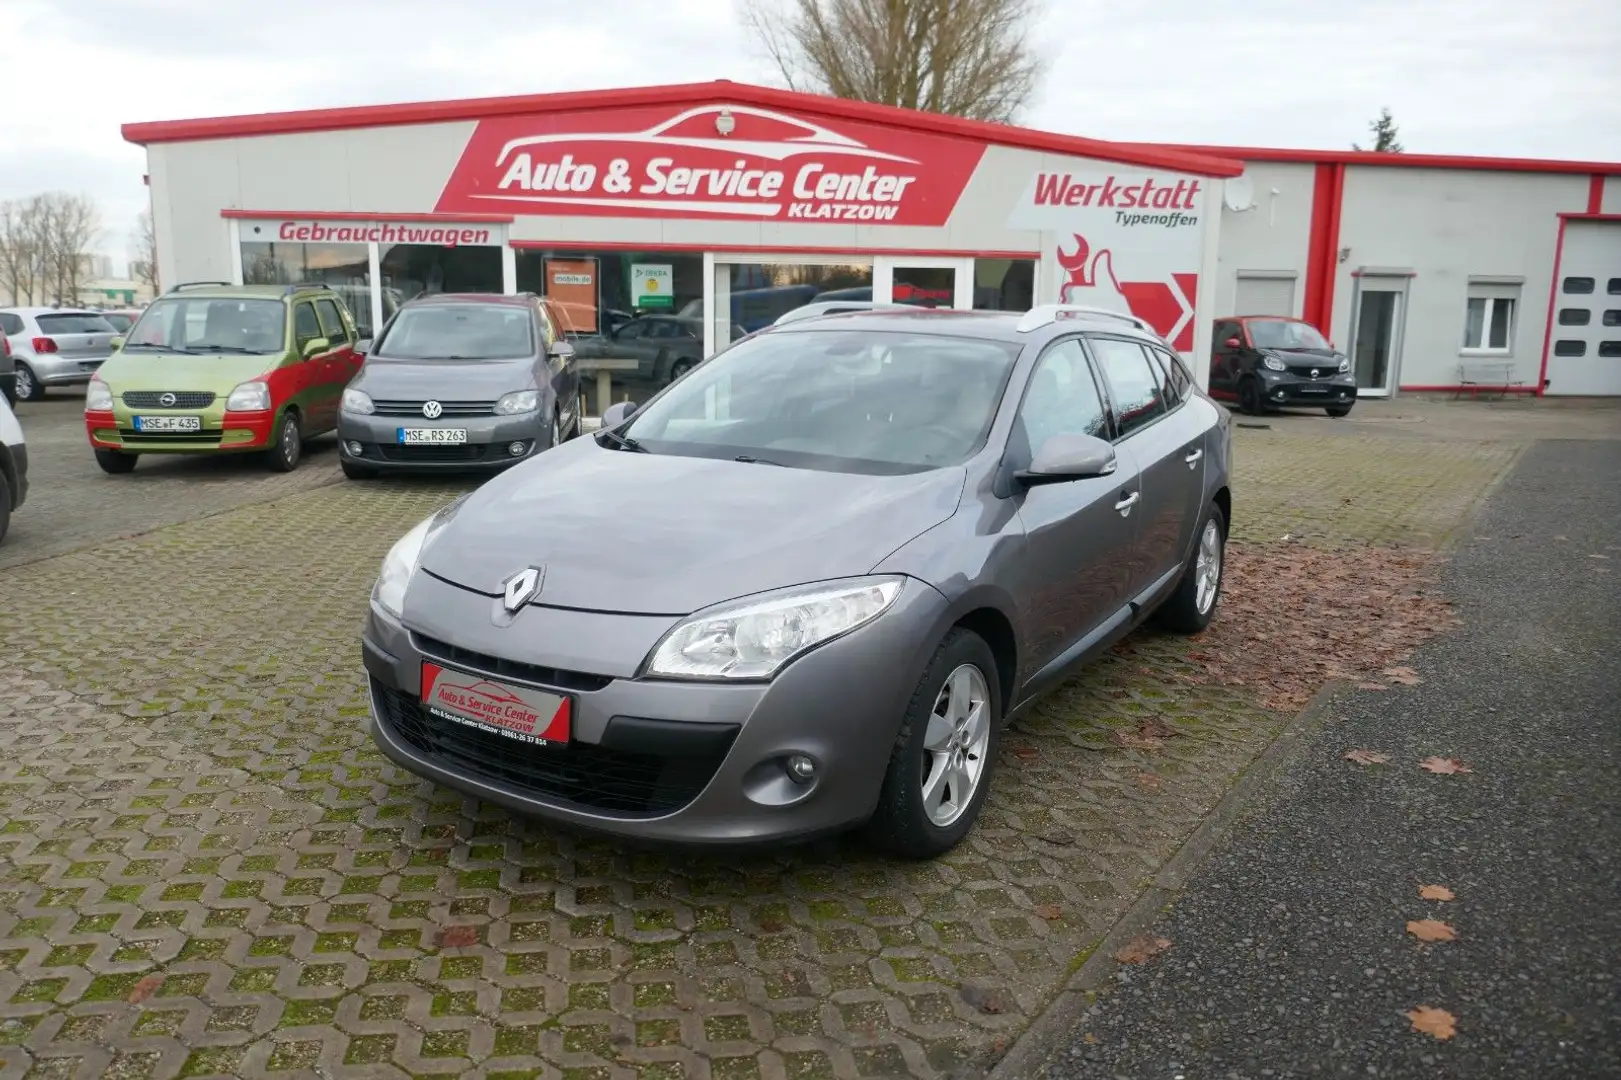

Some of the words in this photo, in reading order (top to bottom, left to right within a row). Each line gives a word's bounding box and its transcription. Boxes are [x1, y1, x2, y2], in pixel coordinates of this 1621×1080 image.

[498, 152, 597, 193] Auto
[602, 158, 634, 194] &
[639, 156, 785, 199] Service
[792, 161, 917, 202] Center
[1033, 173, 1202, 210] Werkstatt
[787, 202, 900, 221] KLATZOW
[1115, 210, 1198, 227] Typenoffen
[279, 220, 489, 248] Gebrauchtwagen
[141, 417, 163, 430] MSE
[168, 417, 176, 429] F
[178, 416, 199, 429] 435
[405, 430, 424, 441] MSE
[431, 430, 445, 441] RS
[446, 430, 465, 441] 263
[438, 688, 458, 703] Auto
[458, 695, 466, 706] &
[467, 697, 502, 715] Service
[504, 706, 540, 724] Center
[485, 715, 535, 733] KLATZOW
